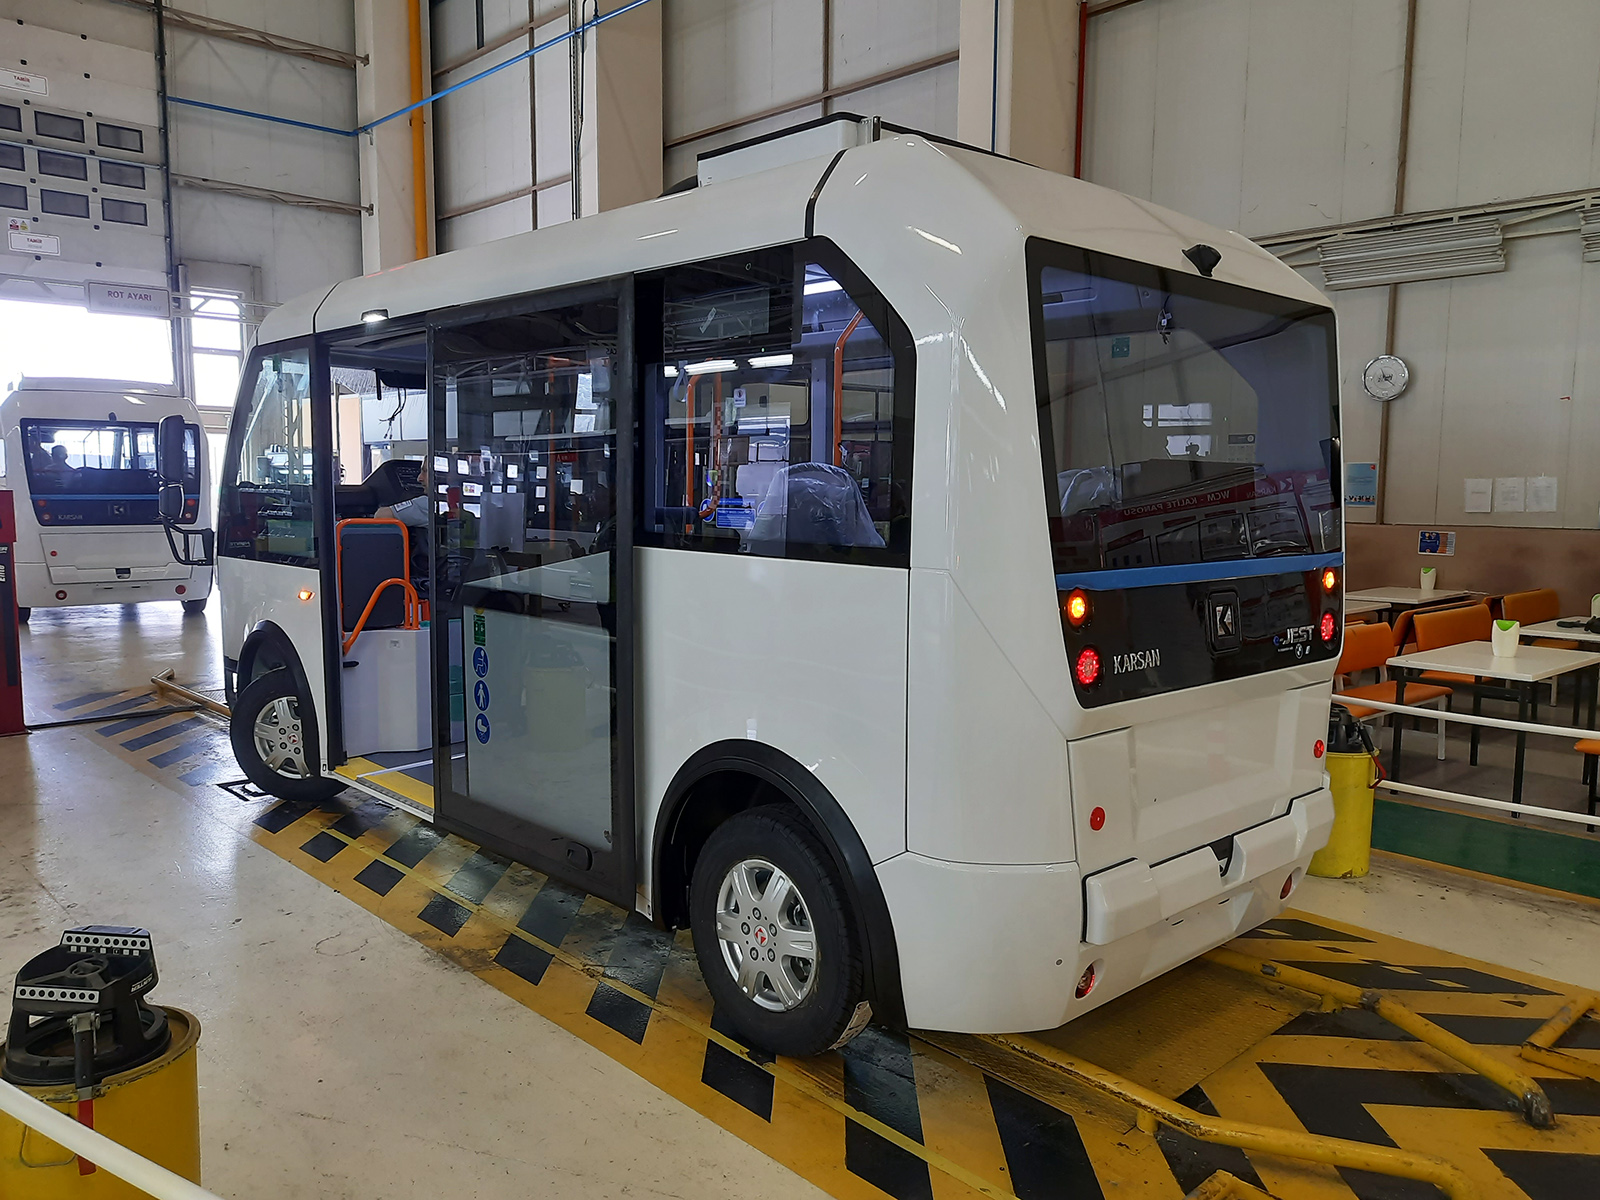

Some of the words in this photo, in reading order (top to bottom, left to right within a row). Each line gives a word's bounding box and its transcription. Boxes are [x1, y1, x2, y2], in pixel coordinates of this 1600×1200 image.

[107, 290, 124, 299] ROT
[127, 292, 152, 301] AYARI
[1113, 648, 1161, 675] KARSAN
